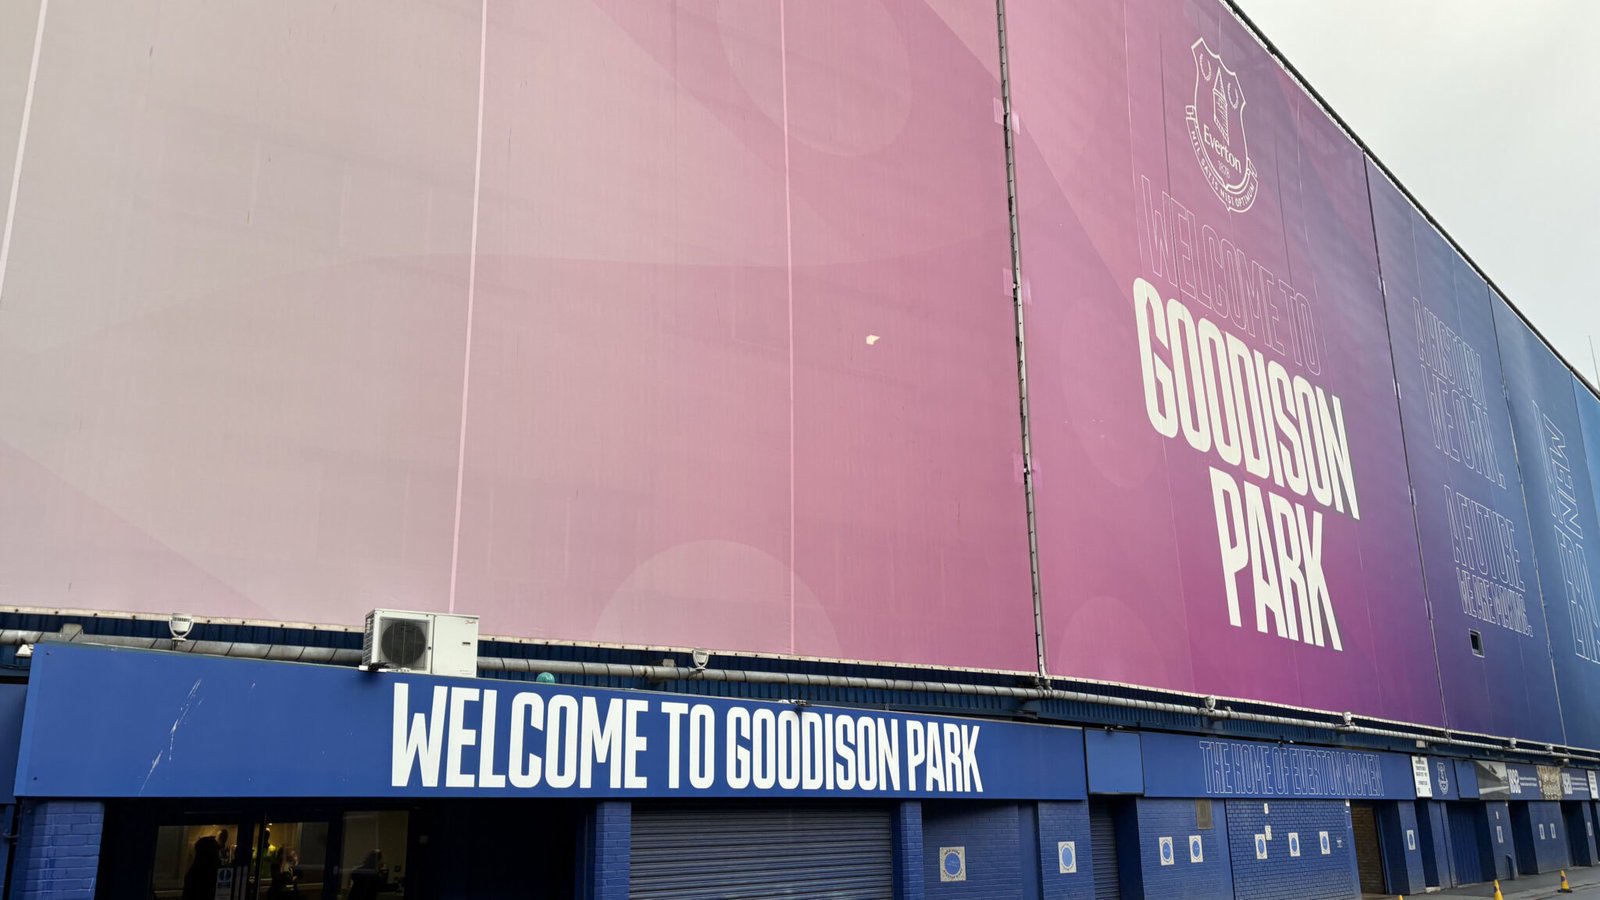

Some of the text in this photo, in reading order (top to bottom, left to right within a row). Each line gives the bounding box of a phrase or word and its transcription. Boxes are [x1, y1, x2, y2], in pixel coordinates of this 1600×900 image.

[1191, 130, 1201, 153] NIL
[1200, 158, 1219, 191] SATIS
[1203, 123, 1242, 174] Everton
[1141, 174, 1321, 376] WELCOME TO
[1412, 296, 1431, 366] A
[1133, 277, 1360, 520] GOODISON
[1421, 364, 1460, 462] WE
[1209, 466, 1343, 652] PARK
[1444, 484, 1525, 592] A FUTURE
[1456, 567, 1477, 617] WE
[1472, 574, 1497, 625] ARE
[391, 682, 984, 793] WELCOME TO GOODISON PARK
[1200, 741, 1232, 794] THE
[1231, 744, 1273, 795] HOME
[1272, 746, 1290, 795] OF
[1289, 748, 1346, 796] EVERTON
[1344, 752, 1385, 797] WOMEN
